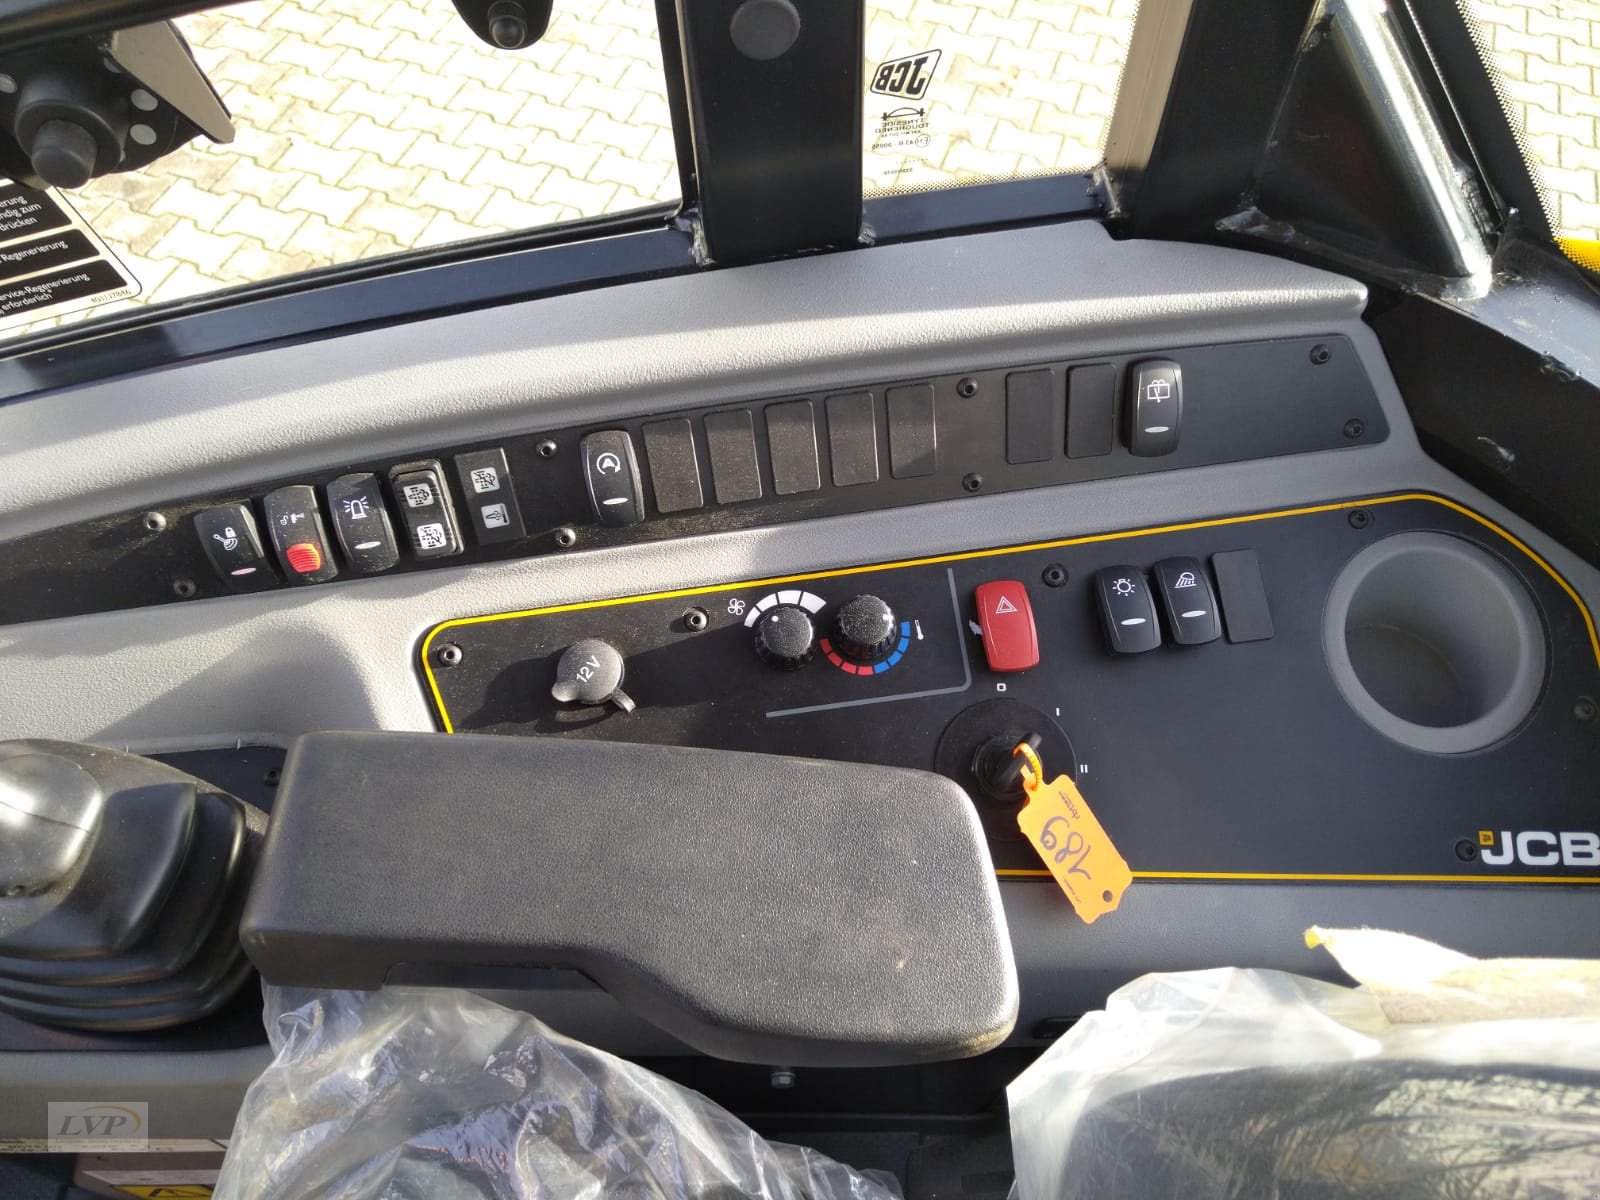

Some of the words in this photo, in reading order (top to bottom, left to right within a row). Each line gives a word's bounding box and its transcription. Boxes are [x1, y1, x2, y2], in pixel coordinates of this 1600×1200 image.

[19, 203, 42, 214] zum
[0, 240, 69, 262] Regenerierung
[1040, 815, 1092, 881] 189
[1480, 831, 1600, 866] JCB
